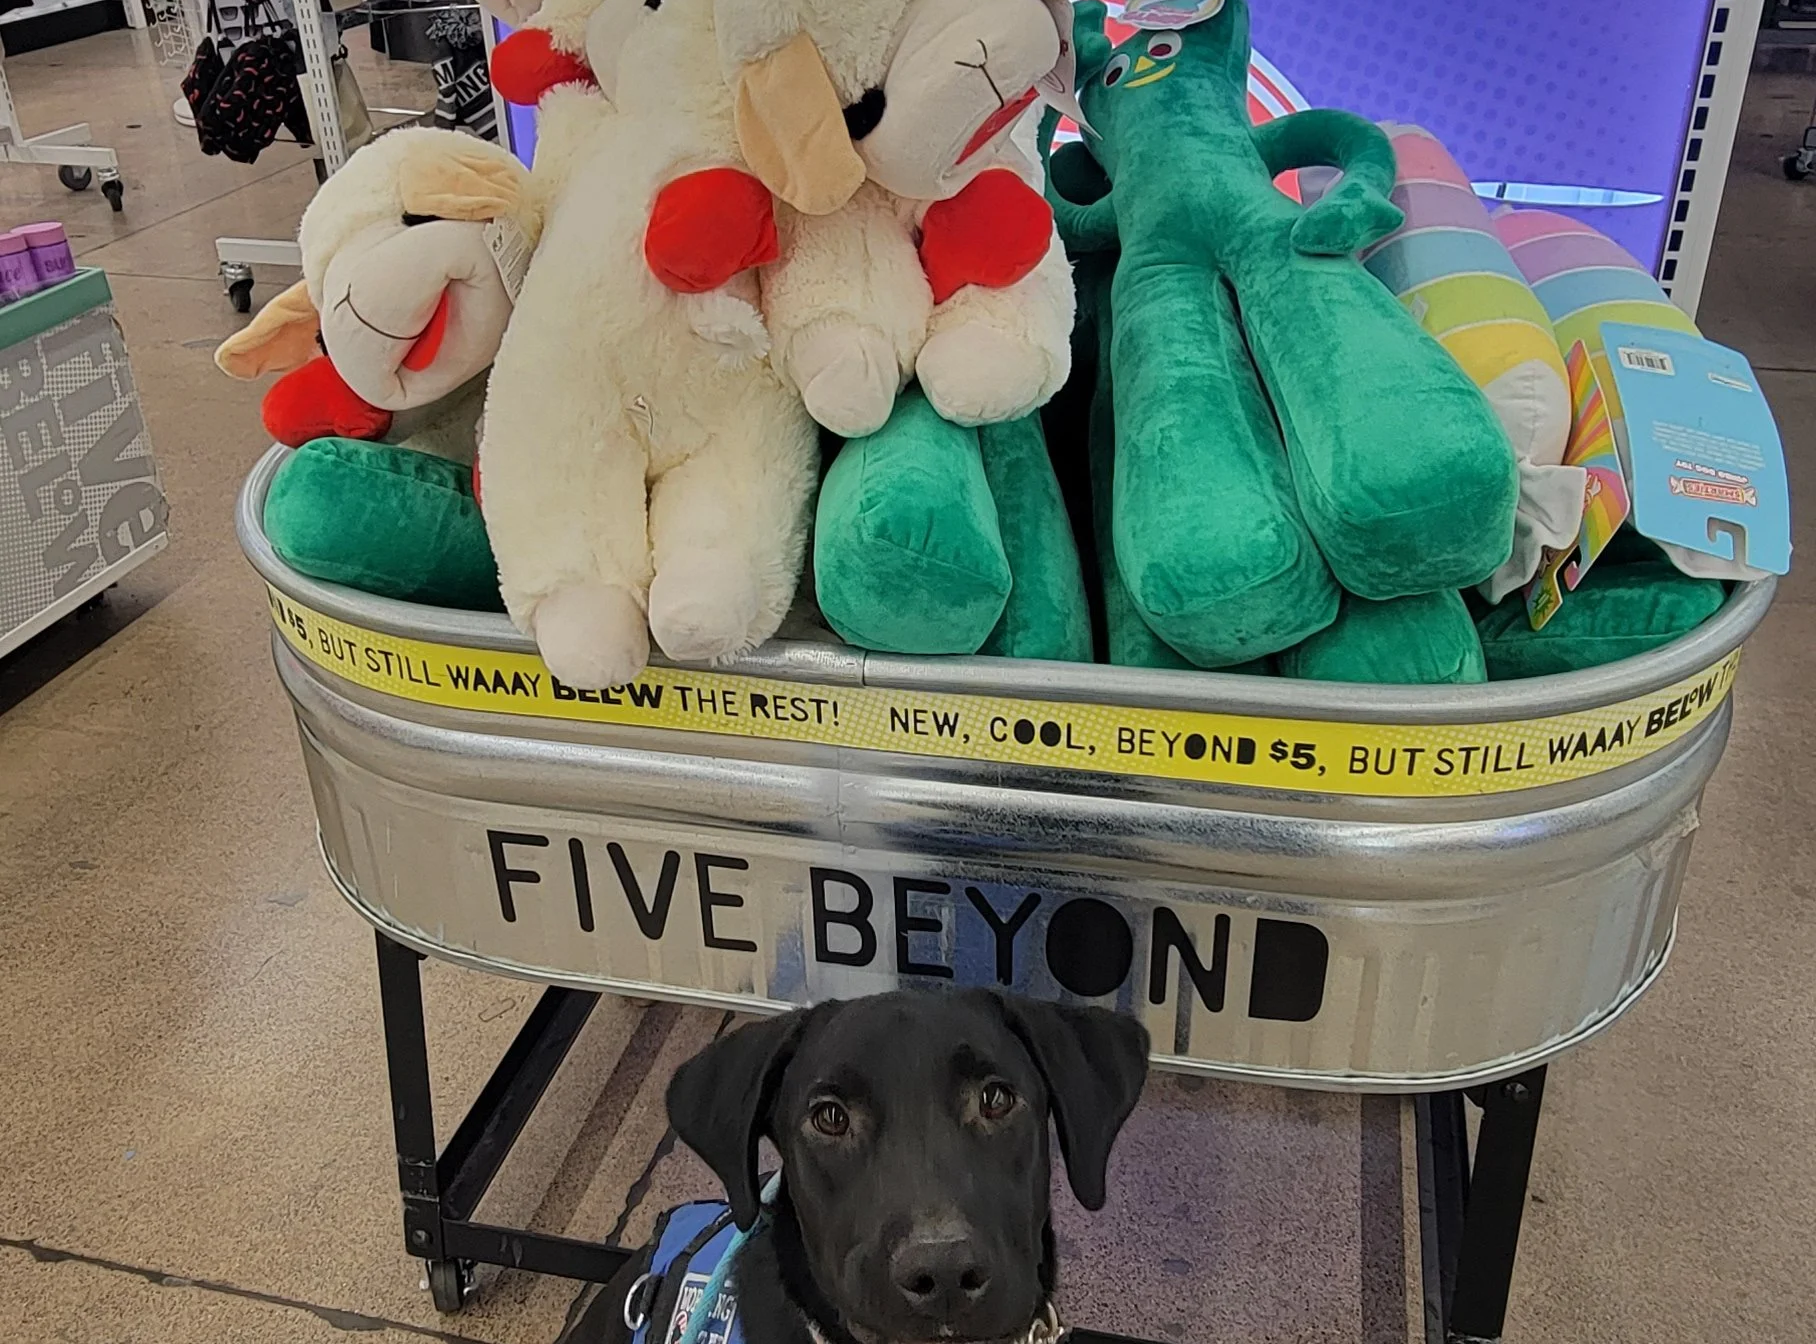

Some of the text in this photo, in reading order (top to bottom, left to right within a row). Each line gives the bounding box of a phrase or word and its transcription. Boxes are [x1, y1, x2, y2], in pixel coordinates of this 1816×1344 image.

[288, 609, 314, 649] $5,
[317, 627, 357, 666] BUT
[364, 647, 442, 688] STILL
[446, 662, 541, 700] WAAAY
[673, 685, 740, 717] THE
[750, 692, 840, 727] REST!
[889, 706, 971, 745] NEW,
[989, 716, 1097, 756] COOL,
[1117, 726, 1257, 766] BEYOND
[1268, 739, 1328, 777] $5,
[1348, 745, 1426, 777] BUT
[1432, 741, 1536, 776] STILL
[1547, 715, 1642, 765] WAAAY
[485, 828, 1330, 1023] FIVE BEYOND
